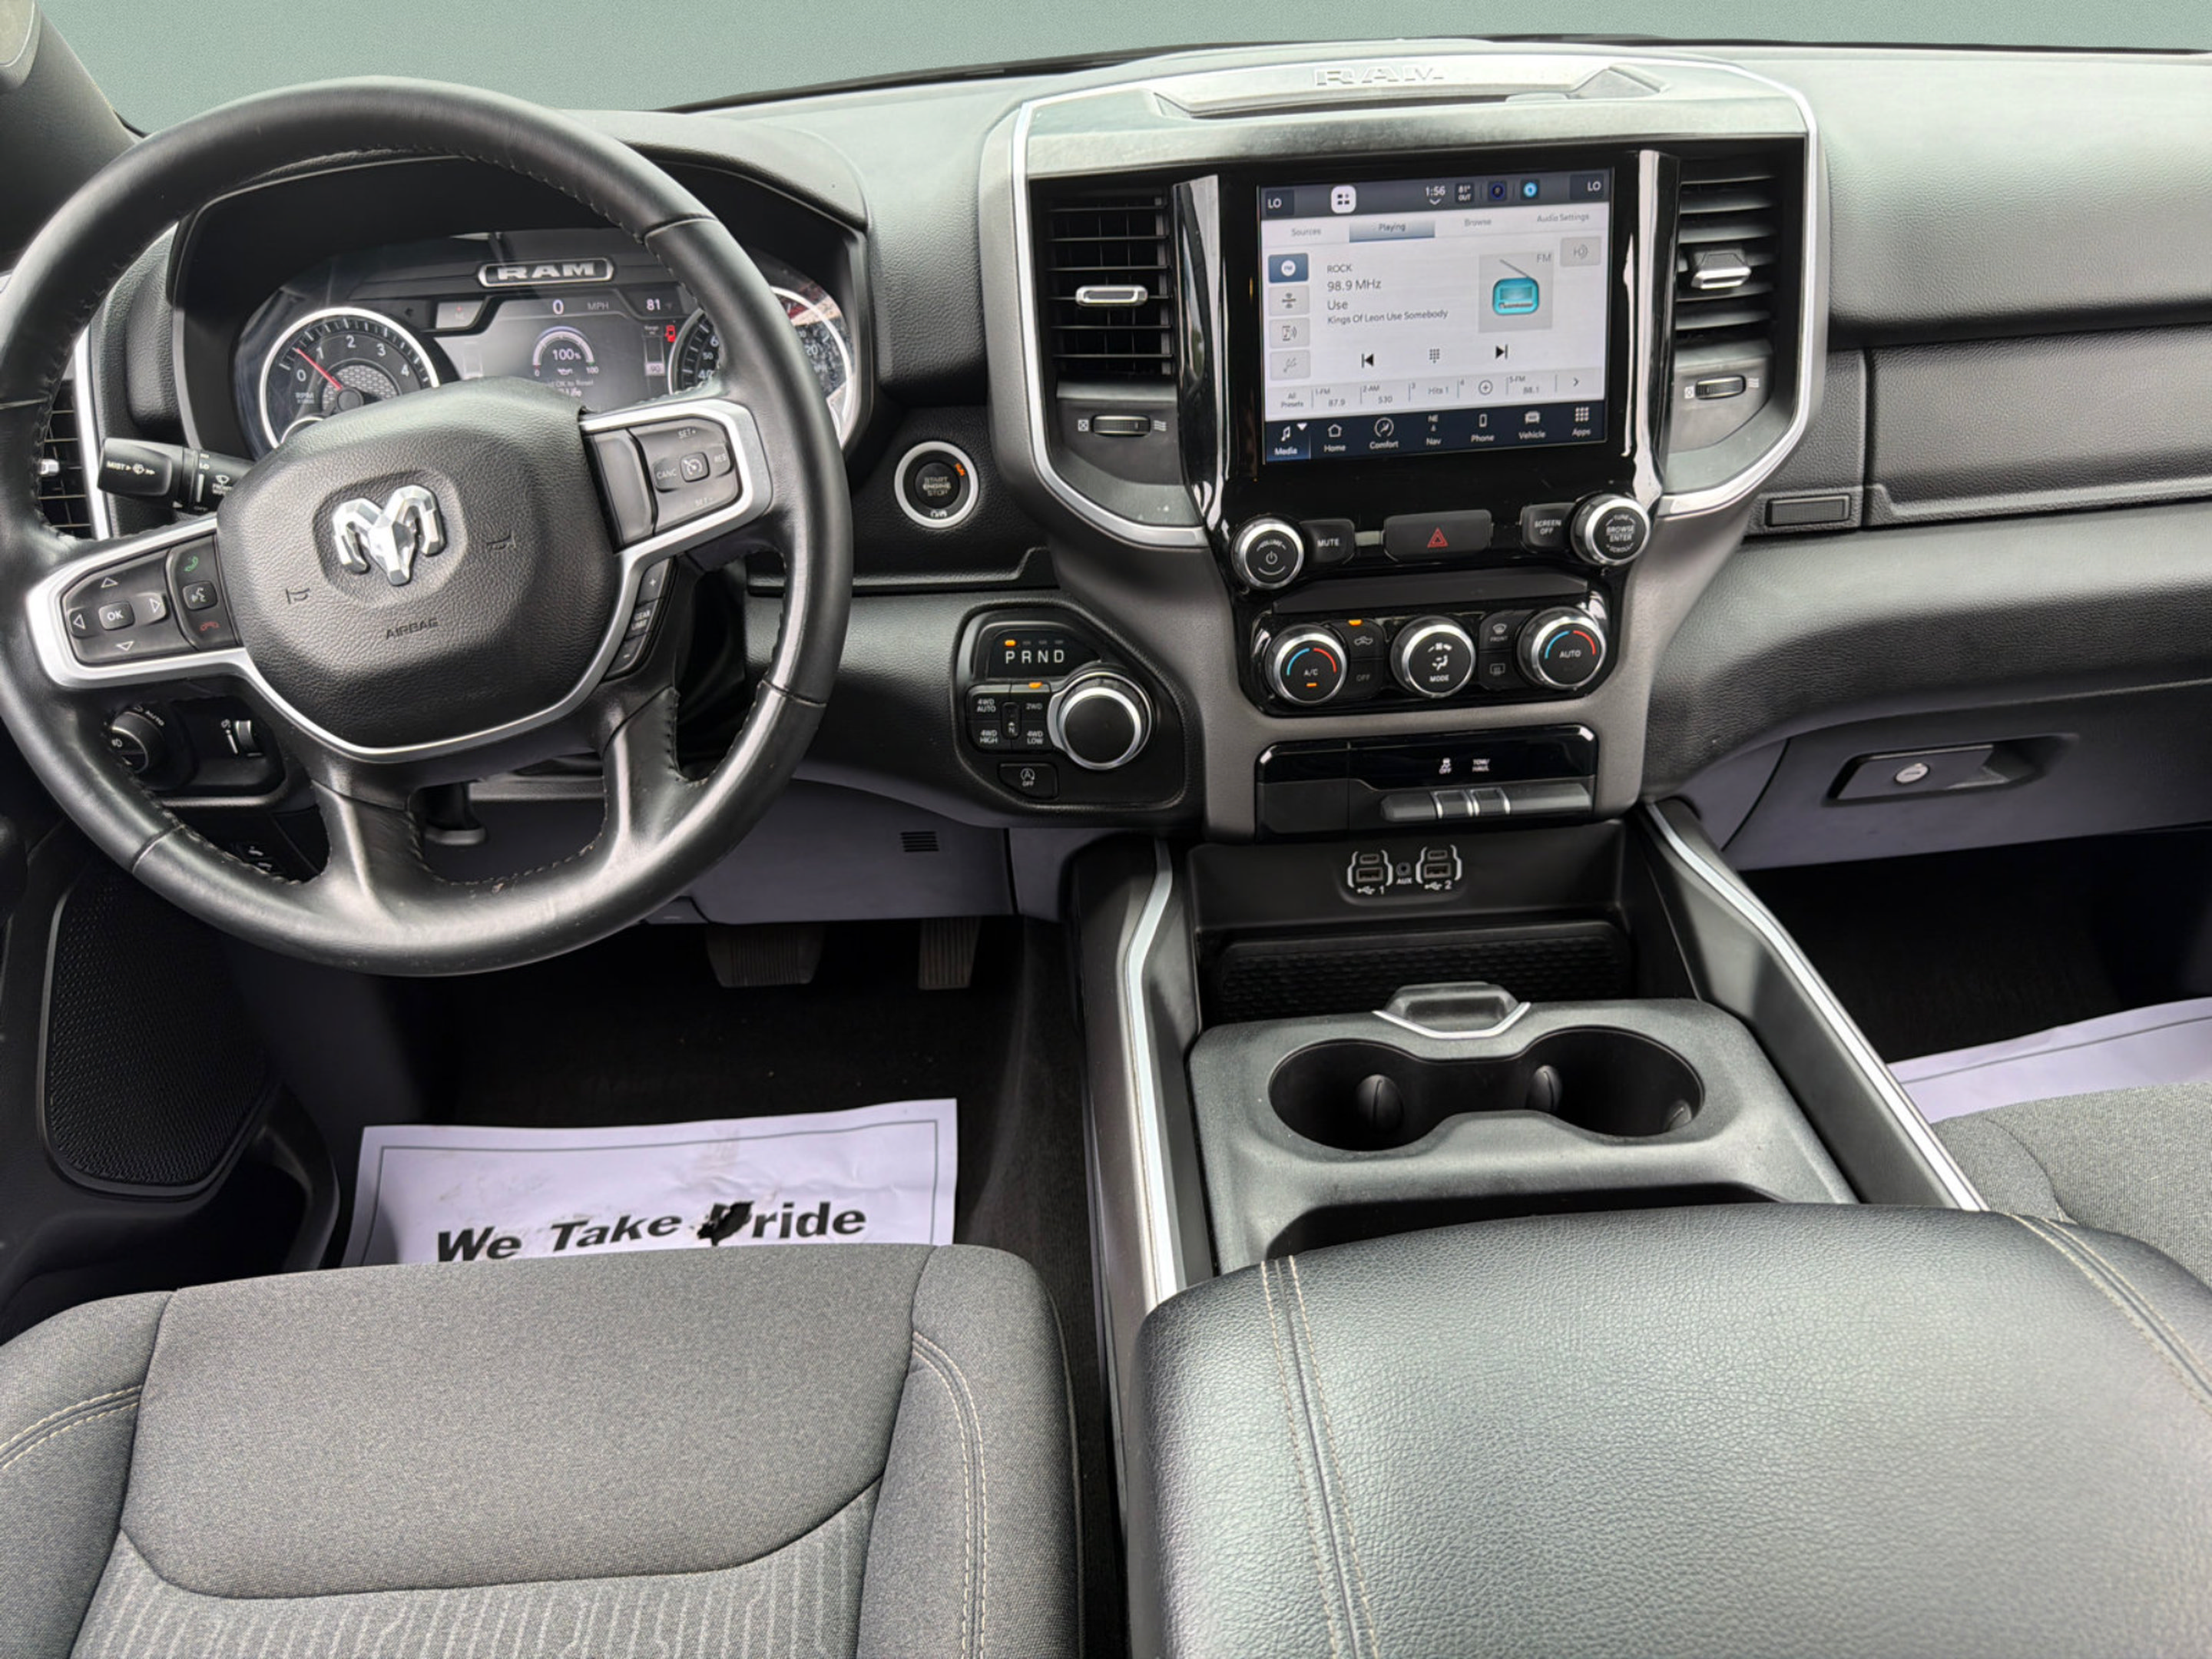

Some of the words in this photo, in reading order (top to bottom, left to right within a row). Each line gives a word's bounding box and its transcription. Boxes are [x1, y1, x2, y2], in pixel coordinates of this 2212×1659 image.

[1315, 66, 1445, 86] RAM
[1587, 180, 1601, 191] LO
[1426, 185, 1445, 197] 1:56
[1267, 198, 1283, 209] LO
[1464, 218, 1492, 227] Browse
[1537, 214, 1558, 223] Audio
[1560, 212, 1590, 222] Settings
[1291, 228, 1322, 237] Sources
[1378, 223, 1406, 232] Playing
[1536, 253, 1551, 263] FM
[497, 263, 595, 280] RAM
[1327, 263, 1353, 273] ROCK
[1327, 280, 1353, 292] 98.9
[1355, 279, 1382, 290] MHz
[552, 299, 565, 315] 0
[587, 300, 610, 311] MPH
[646, 298, 661, 311] 81
[1327, 300, 1349, 310] Use
[1327, 316, 1352, 325] Kings
[1353, 314, 1363, 323] Of
[1365, 313, 1385, 323] Leon
[1386, 313, 1402, 321] Use
[1404, 310, 1449, 320] Somebody
[346, 335, 356, 348] 2
[316, 346, 324, 359] 1
[376, 343, 386, 356] 3
[703, 352, 714, 360] 50
[401, 363, 409, 376] 4
[296, 369, 306, 382] 0
[1518, 430, 1546, 439] Vehicle
[1571, 428, 1591, 437] Apps
[1470, 434, 1495, 442] Phone
[1323, 444, 1346, 452] Home
[1369, 440, 1399, 449] Comfort
[1274, 447, 1298, 455] Media
[106, 460, 126, 471] MIST
[656, 468, 677, 480] CANC
[1534, 518, 1562, 528] SCREEN
[1539, 527, 1555, 535] OFF
[1605, 525, 1635, 535] BROWSE
[1609, 533, 1633, 542] ENTER
[1316, 538, 1340, 548] MUTE
[107, 611, 124, 621] OK
[1558, 650, 1581, 659] AUTO
[1303, 668, 1319, 677] A/C
[1429, 674, 1450, 683] MODE
[976, 704, 997, 713] AUTO
[979, 736, 998, 744] HIGH
[1026, 737, 1044, 745] LOW
[1444, 879, 1452, 890] 2
[1379, 886, 1385, 895] 1
[437, 1226, 522, 1263] We
[549, 1214, 683, 1253] Take
[702, 1200, 867, 1240] ride
